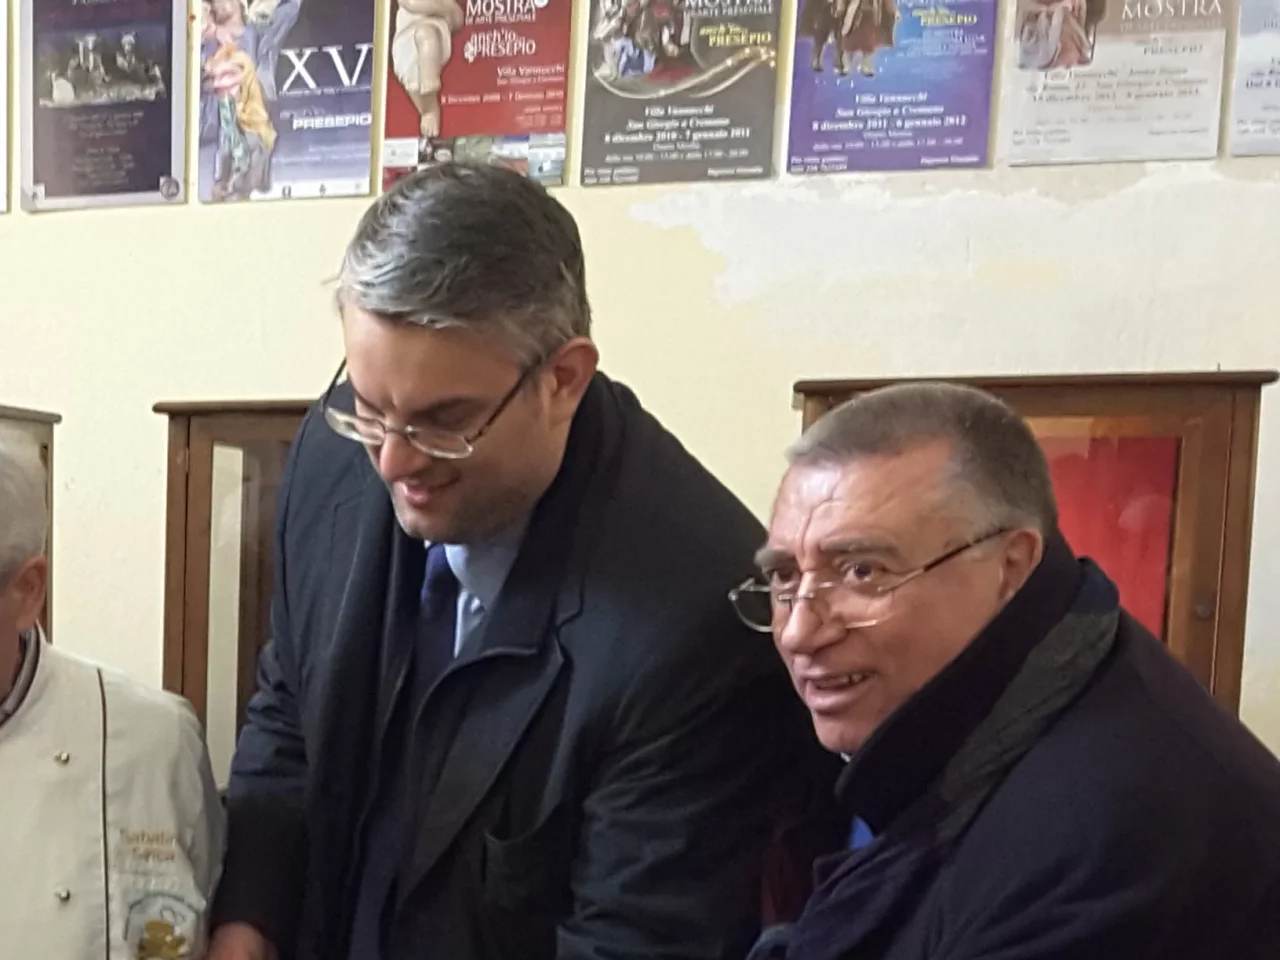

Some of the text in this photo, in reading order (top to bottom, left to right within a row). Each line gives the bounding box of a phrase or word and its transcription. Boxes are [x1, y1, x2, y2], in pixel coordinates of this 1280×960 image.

[466, 0, 536, 16] MOSTRA
[1122, 0, 1222, 20] MOSTRA
[280, 42, 373, 92] XV
